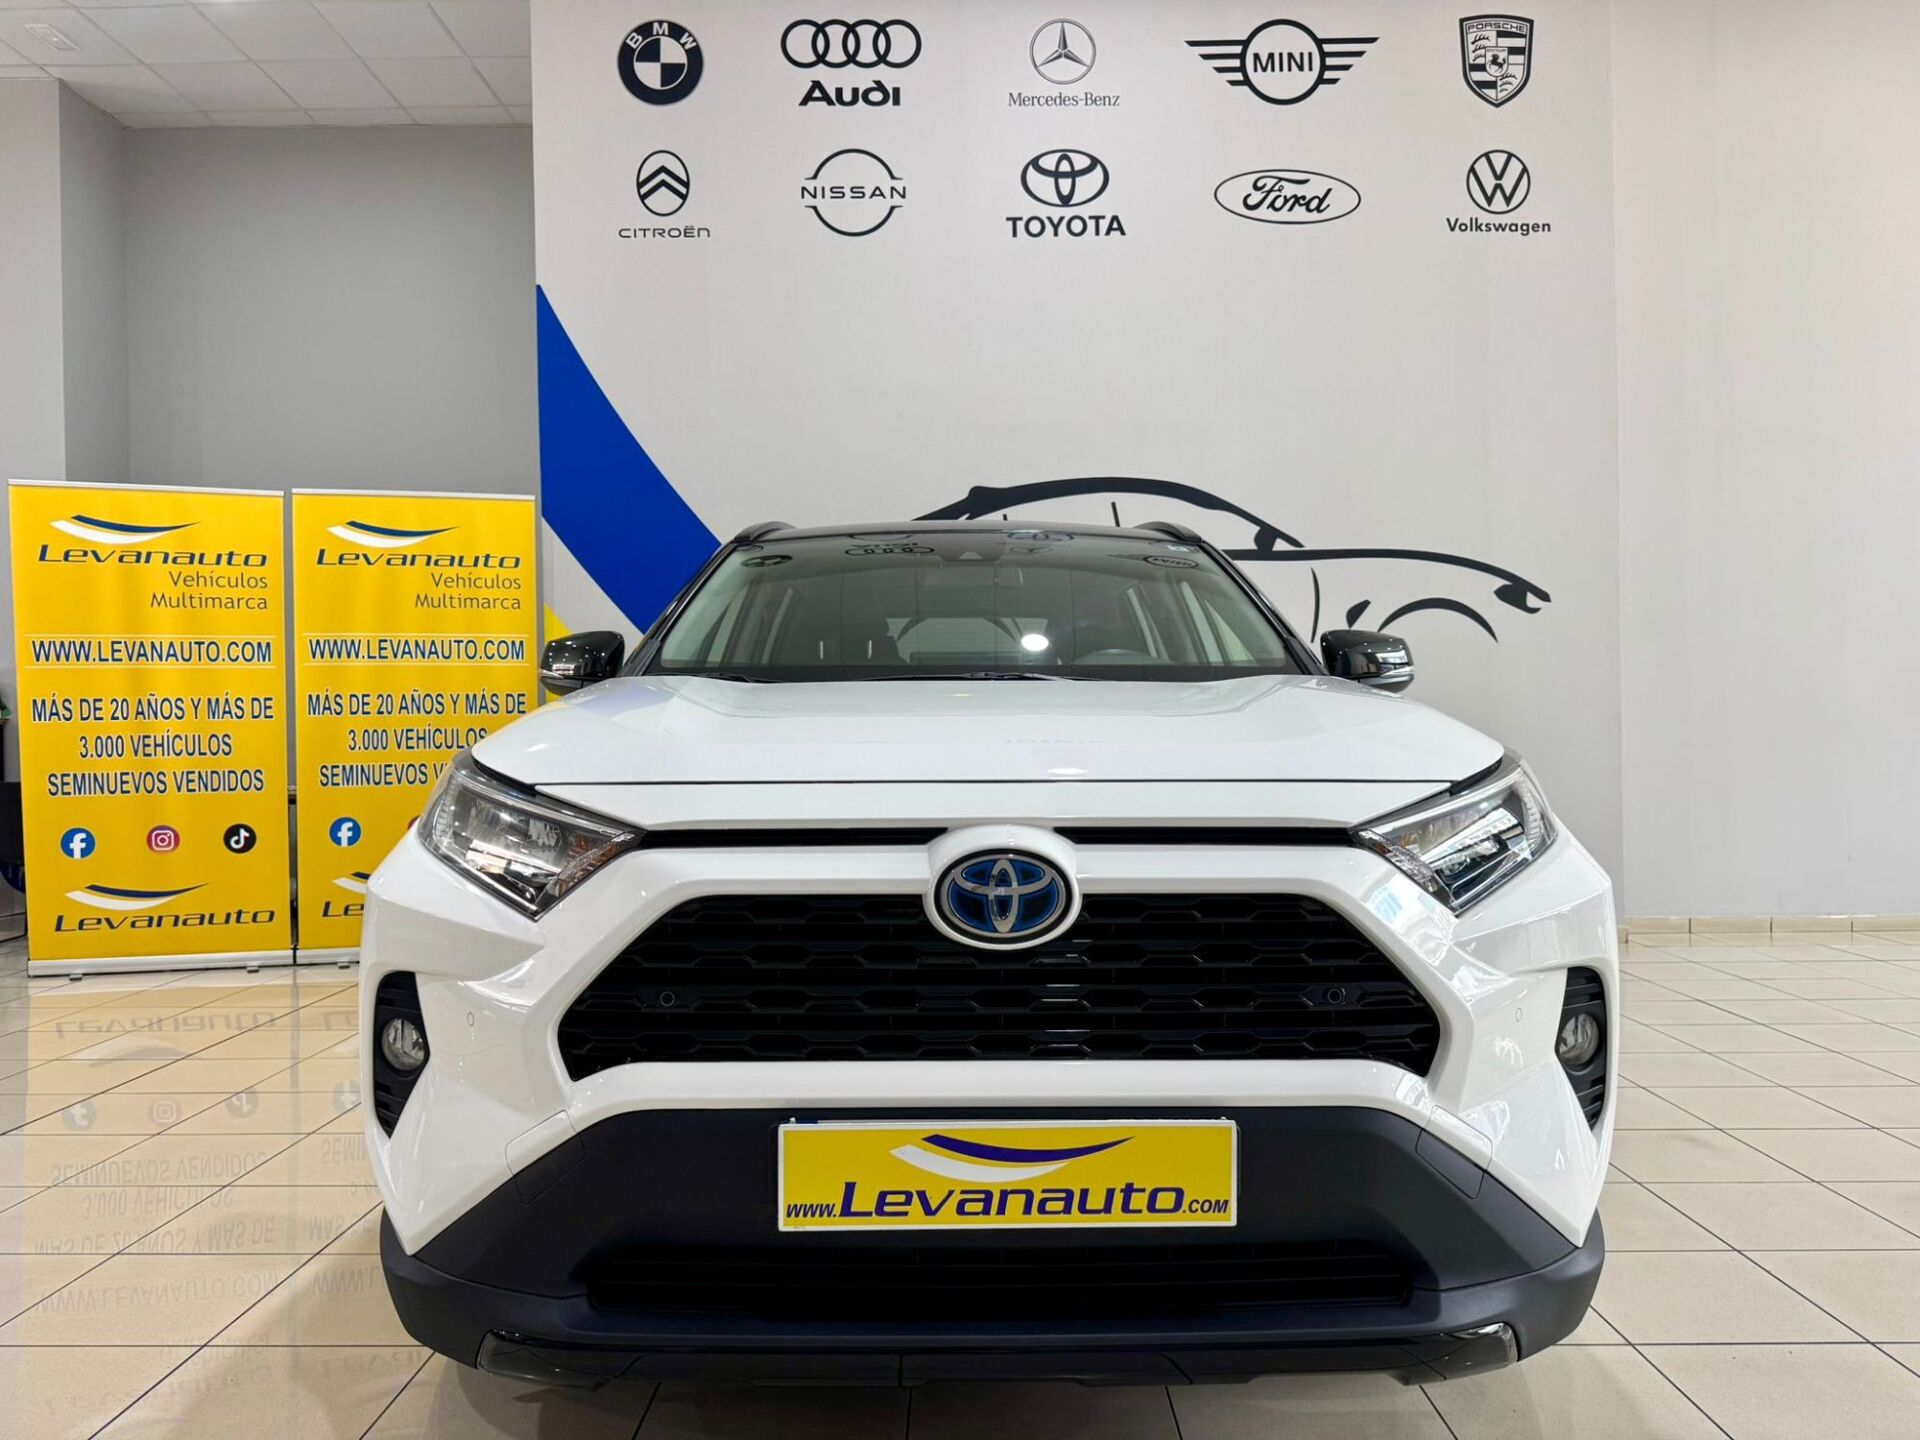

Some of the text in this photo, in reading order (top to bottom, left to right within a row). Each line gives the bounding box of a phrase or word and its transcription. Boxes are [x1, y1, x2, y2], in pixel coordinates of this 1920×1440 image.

[626, 21, 696, 50] BMW
[1467, 22, 1526, 34] PORSCHE
[1252, 51, 1314, 73] MINI
[798, 80, 900, 106] Audi
[1008, 92, 1120, 107] Mercedes-Benz
[801, 185, 907, 200] NISSAN
[1242, 174, 1333, 214] Ford
[1006, 215, 1127, 238] TOYOTA
[1446, 217, 1551, 236] Volkswagen
[38, 544, 268, 567] Levanauto
[317, 549, 521, 569] Levanauto
[168, 571, 268, 589] Vehículos
[431, 572, 521, 590] Vehículos
[150, 592, 268, 611] Multimarca
[415, 593, 521, 610] Multimarca
[32, 640, 272, 663] WWW.LEVANAUTO.COM
[308, 639, 525, 660] WWW.LEVANAUTO.COM
[32, 692, 274, 722] MÁS DE 20 AÑOS Y MÁS DE
[308, 688, 527, 716] MÁS DE 20 AÑOS Y MÁS DE
[79, 729, 233, 759] 3.000 VEHÍCULOS
[348, 728, 389, 751] 3.000
[47, 769, 264, 797] SEMINUEVOS VENDIDOS
[319, 763, 428, 787] SEMINUEVOS
[54, 908, 275, 932] Levanauto
